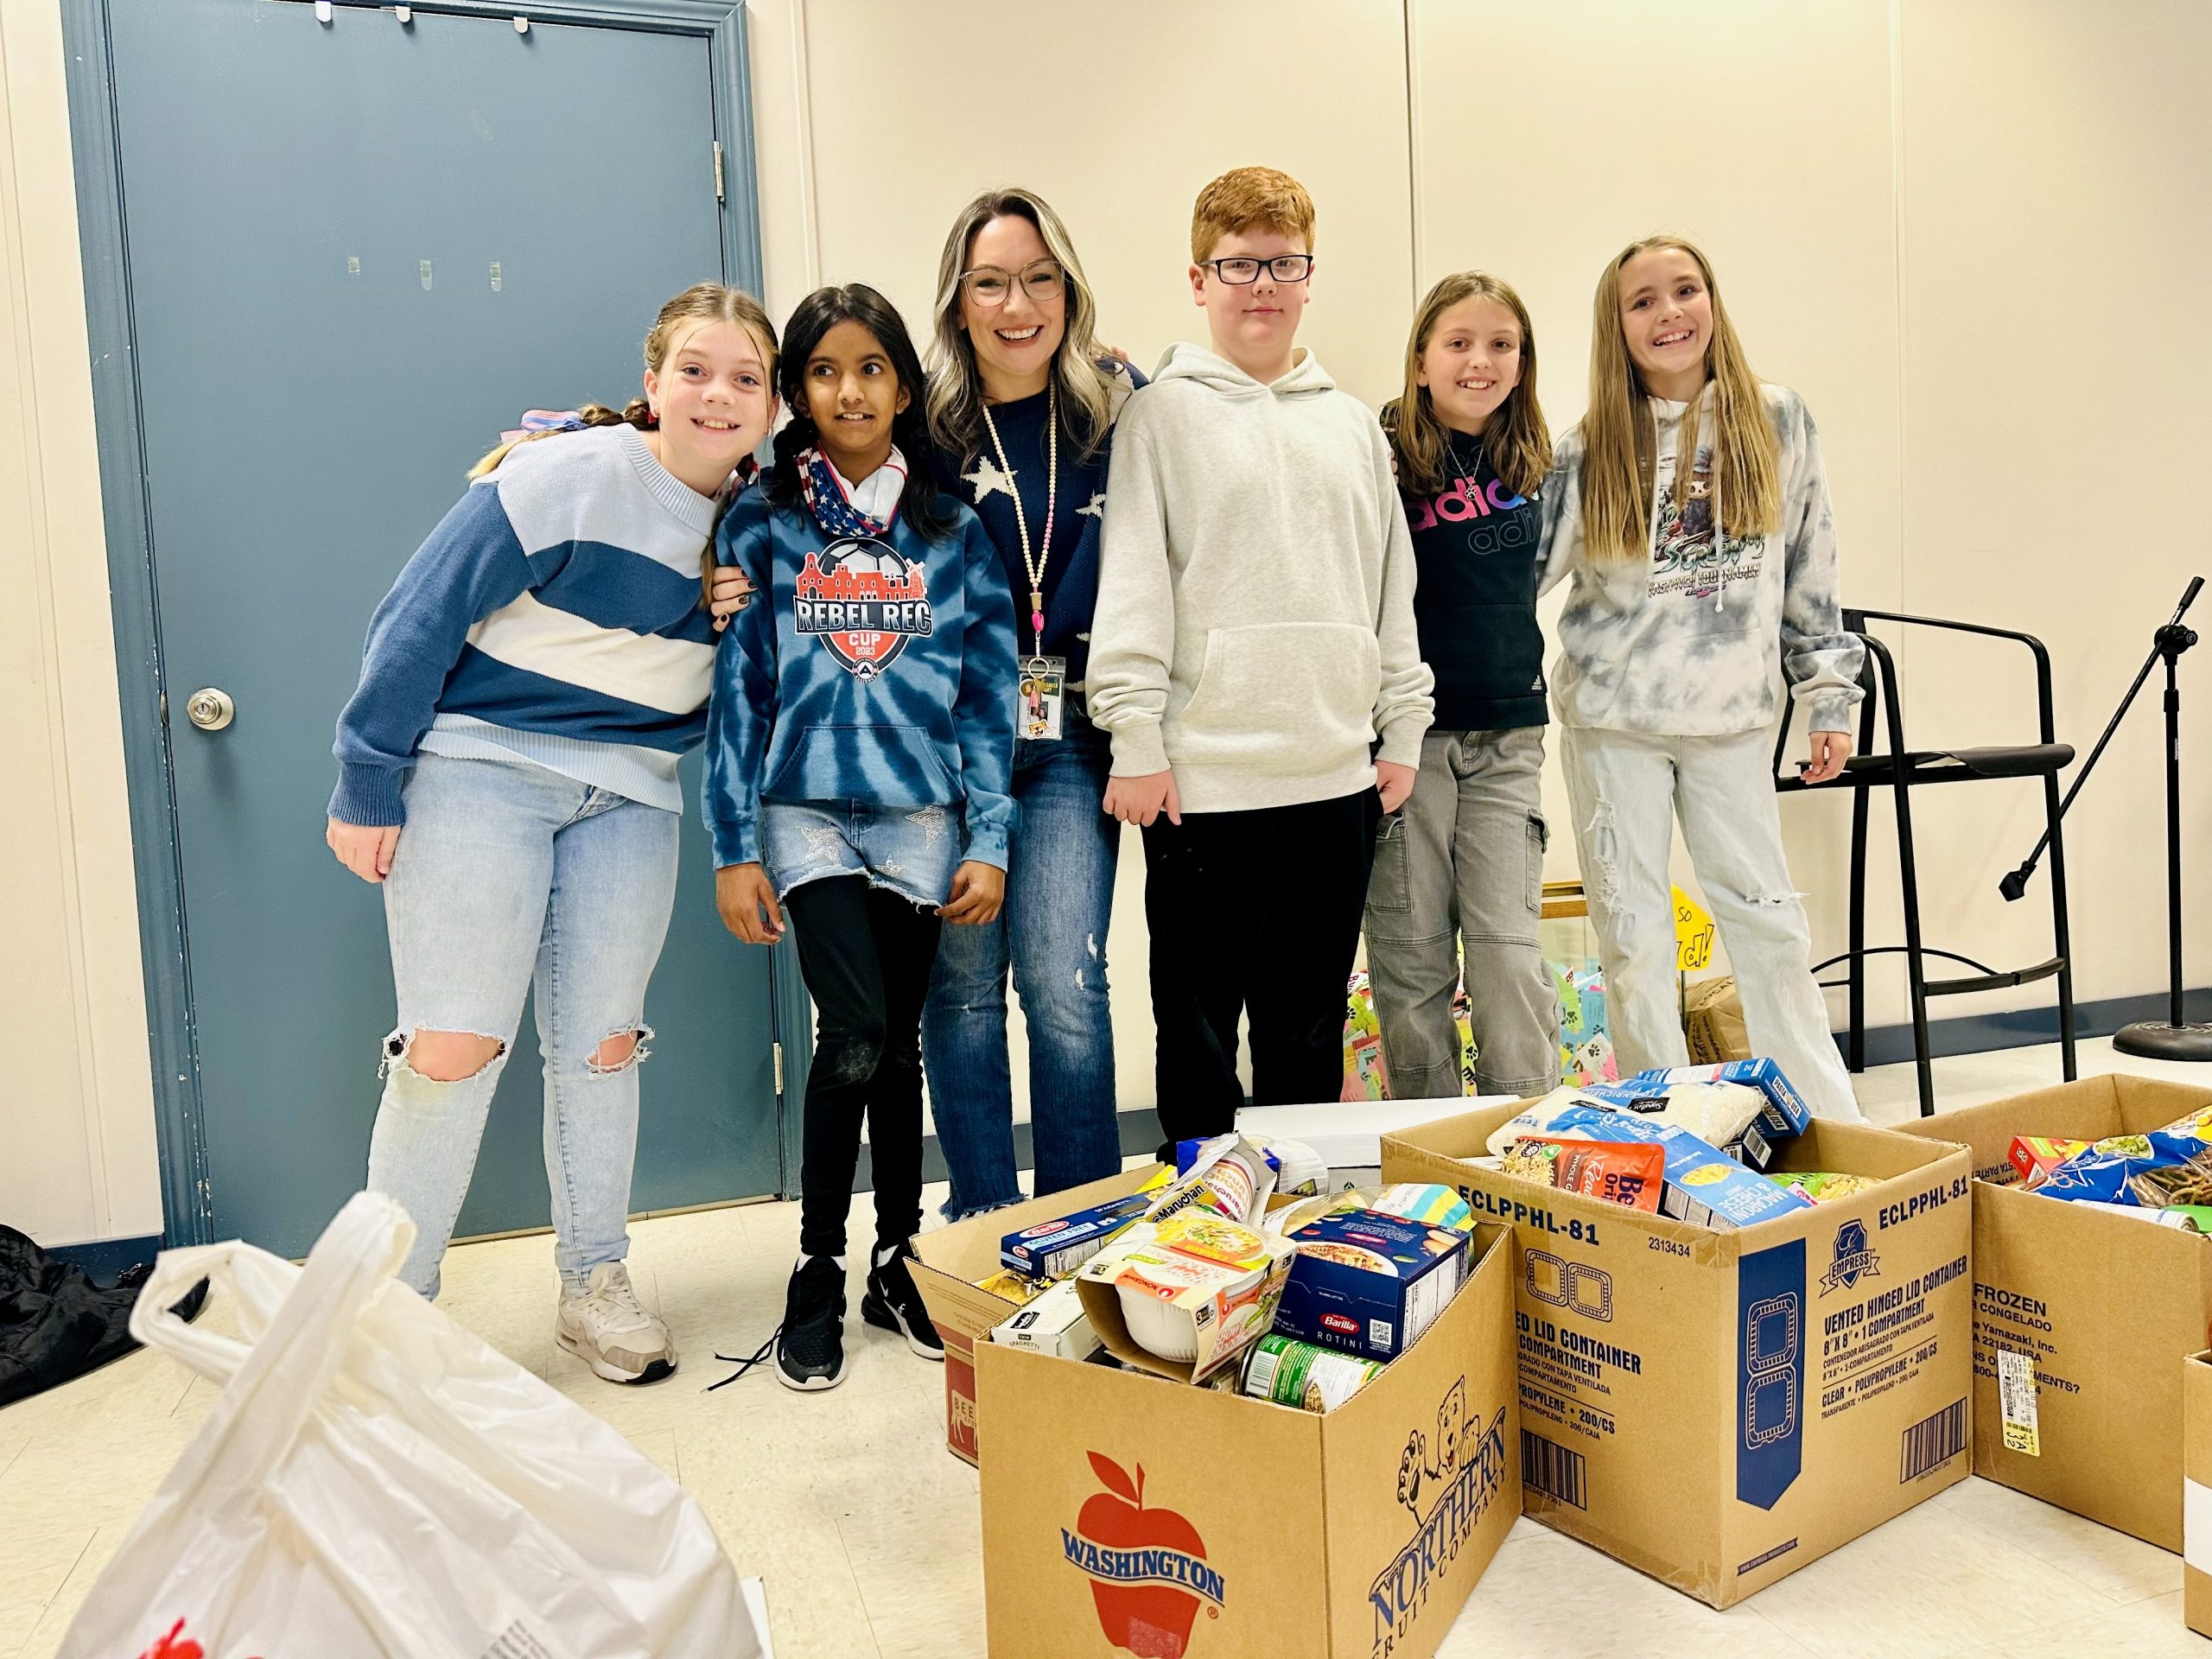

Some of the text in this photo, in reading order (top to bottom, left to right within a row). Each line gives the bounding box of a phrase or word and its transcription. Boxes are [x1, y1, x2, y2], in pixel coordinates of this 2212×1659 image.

[797, 599, 932, 634] REBEL REC
[849, 632, 881, 647] CUP
[855, 647, 875, 656] 2023
[1774, 1077, 1801, 1116] PASTA USA
[1771, 1115, 1786, 1131] USA
[1566, 1154, 1582, 1182] WHOLE
[1999, 1160, 2017, 1173] STA
[1159, 1185, 1205, 1219] Maruchan
[1617, 1174, 1644, 1207] Be
[1718, 1181, 1771, 1213] & CHEESE
[1730, 1189, 1789, 1222] MACARONI
[1879, 1175, 1968, 1230] ECLPPHL-81
[1459, 1185, 1600, 1246] ECLPPHL-81
[1029, 1231, 1067, 1246] GLUTEN
[1067, 1223, 1089, 1236] FREE
[1648, 1236, 1691, 1258] 2313434
[1832, 1252, 1869, 1280] EMPRESS
[1825, 1255, 1967, 1337] VENTED HINGED LID CONTAINER
[1974, 1282, 2047, 1317] FROZEN
[1324, 1316, 1357, 1332] Barilla
[1868, 1298, 1925, 1338] COMPARTMENT
[1980, 1302, 2052, 1332] CONGELADO
[1318, 1331, 1363, 1350] ROTINI
[1535, 1318, 1555, 1343] LID
[1560, 1328, 1642, 1375] CONTAINER
[1822, 1348, 1858, 1370] CONTENEDOR
[1890, 1328, 1900, 1341] CON
[1900, 1321, 1912, 1336] TAPA
[1982, 1321, 2058, 1355] Yamazaki, Inc.
[1518, 1351, 1611, 1396] GRADO CON TAPA VENTILADA
[1519, 1334, 1602, 1380] COMPARTMENT
[1821, 1341, 1938, 1408] CLEAR POLYPROPYLENE 200/CS
[2032, 1370, 2081, 1395] MENTS?
[954, 1396, 975, 1417] BEE
[1579, 1408, 1616, 1435] 200/CS
[1821, 1396, 1857, 1421] TRANSPARENTE
[1569, 1421, 1601, 1441] 200/CAJA
[1372, 1421, 1506, 1651] NORTHERN
[1061, 1527, 1225, 1603] WASHINGTON
[1371, 1461, 1507, 1659] RUIT COMPANY
